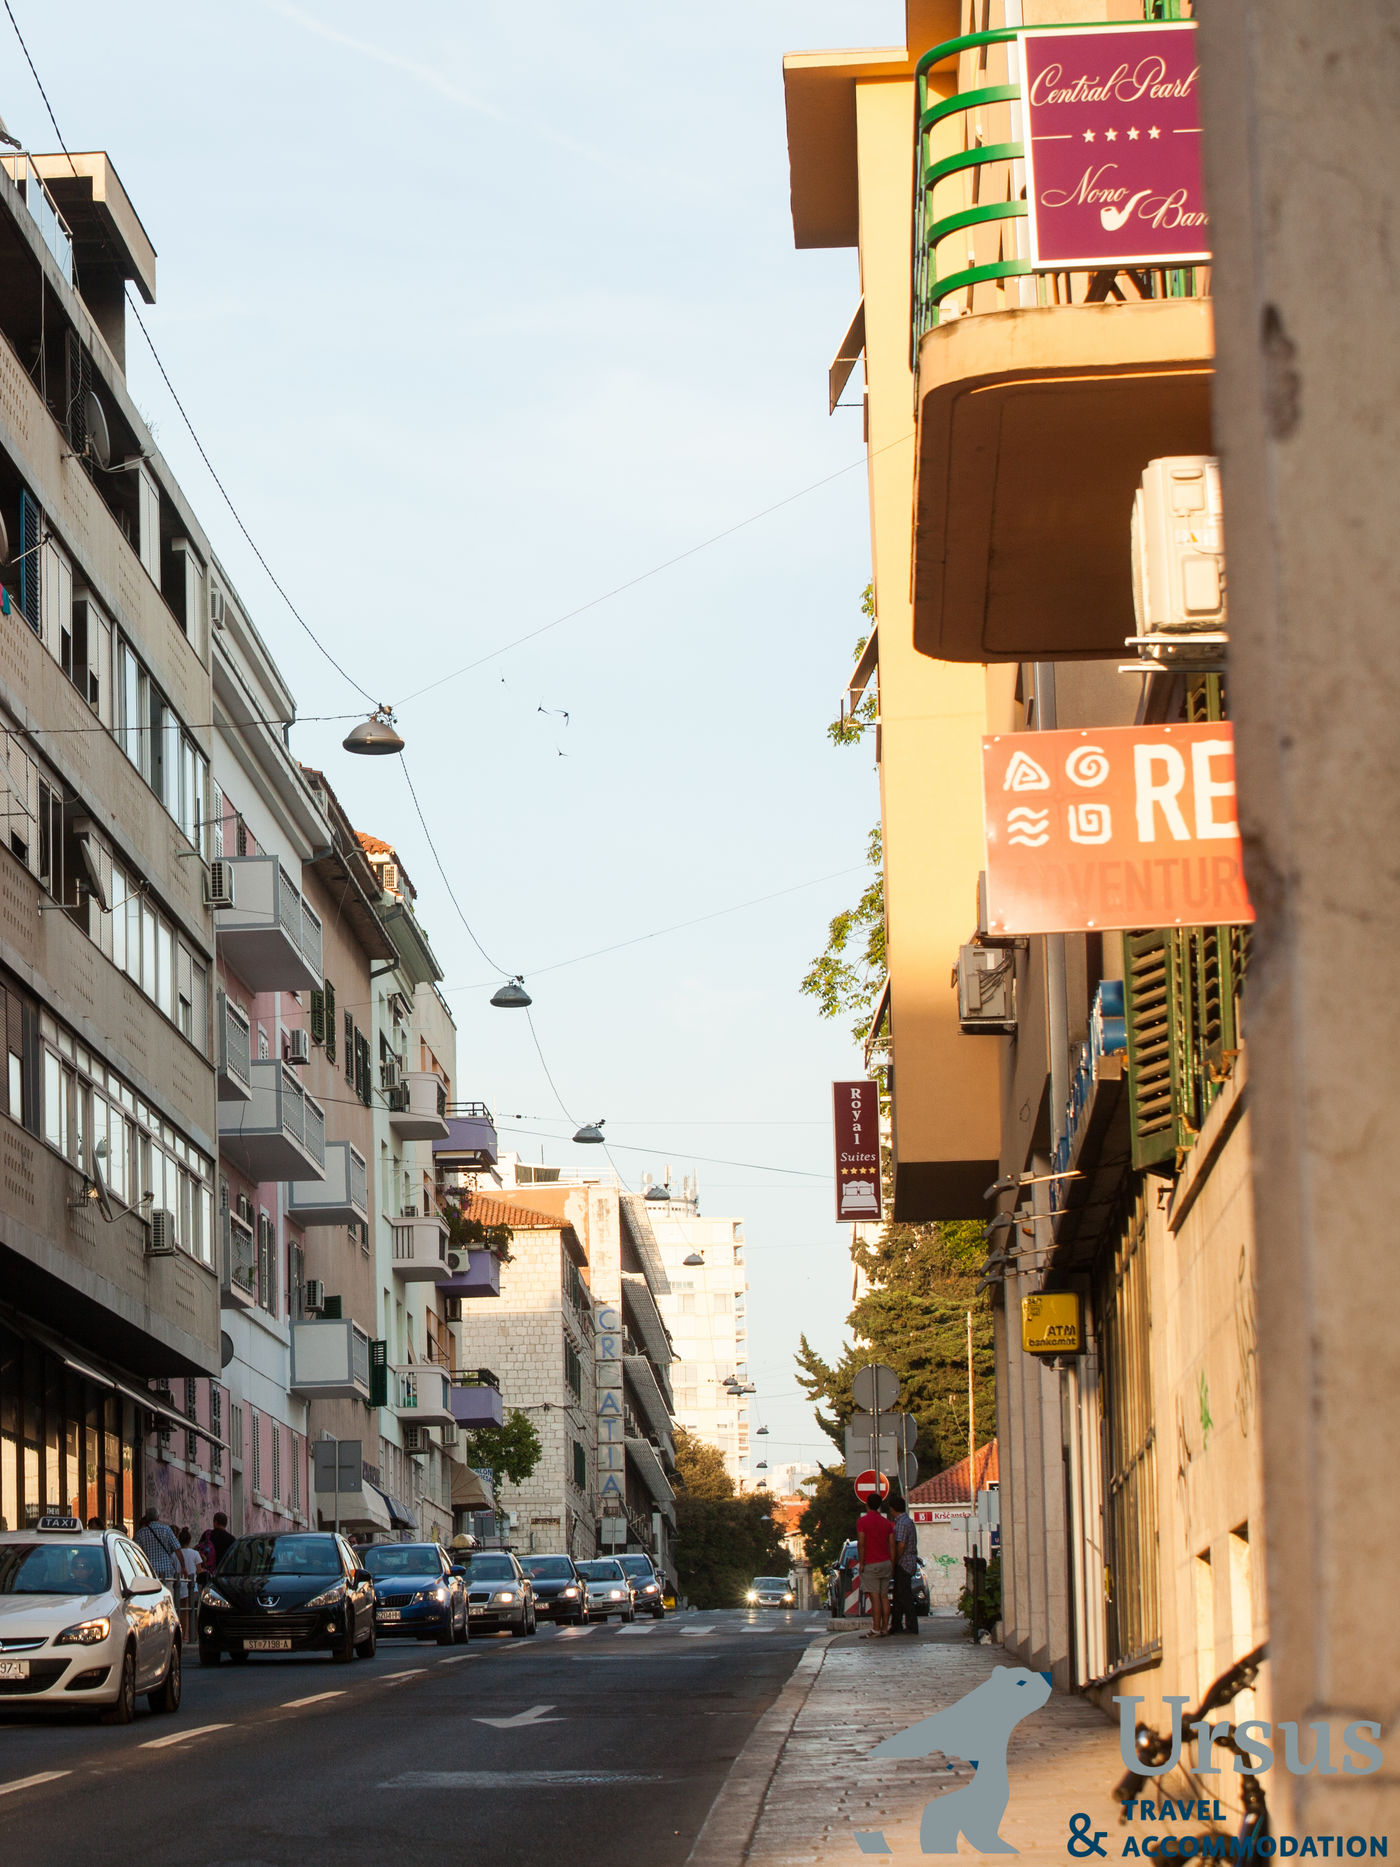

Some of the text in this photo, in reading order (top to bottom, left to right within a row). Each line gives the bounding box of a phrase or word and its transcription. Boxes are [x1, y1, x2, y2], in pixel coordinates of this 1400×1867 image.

[1030, 55, 1200, 107] Central Pearl
[1040, 163, 1130, 208] Nono
[849, 1087, 862, 1145] Royal
[840, 1152, 877, 1162] Suites
[1047, 1325, 1076, 1336] ATM
[1029, 1337, 1076, 1347] bankomat
[46, 1519, 74, 1527] TAXI
